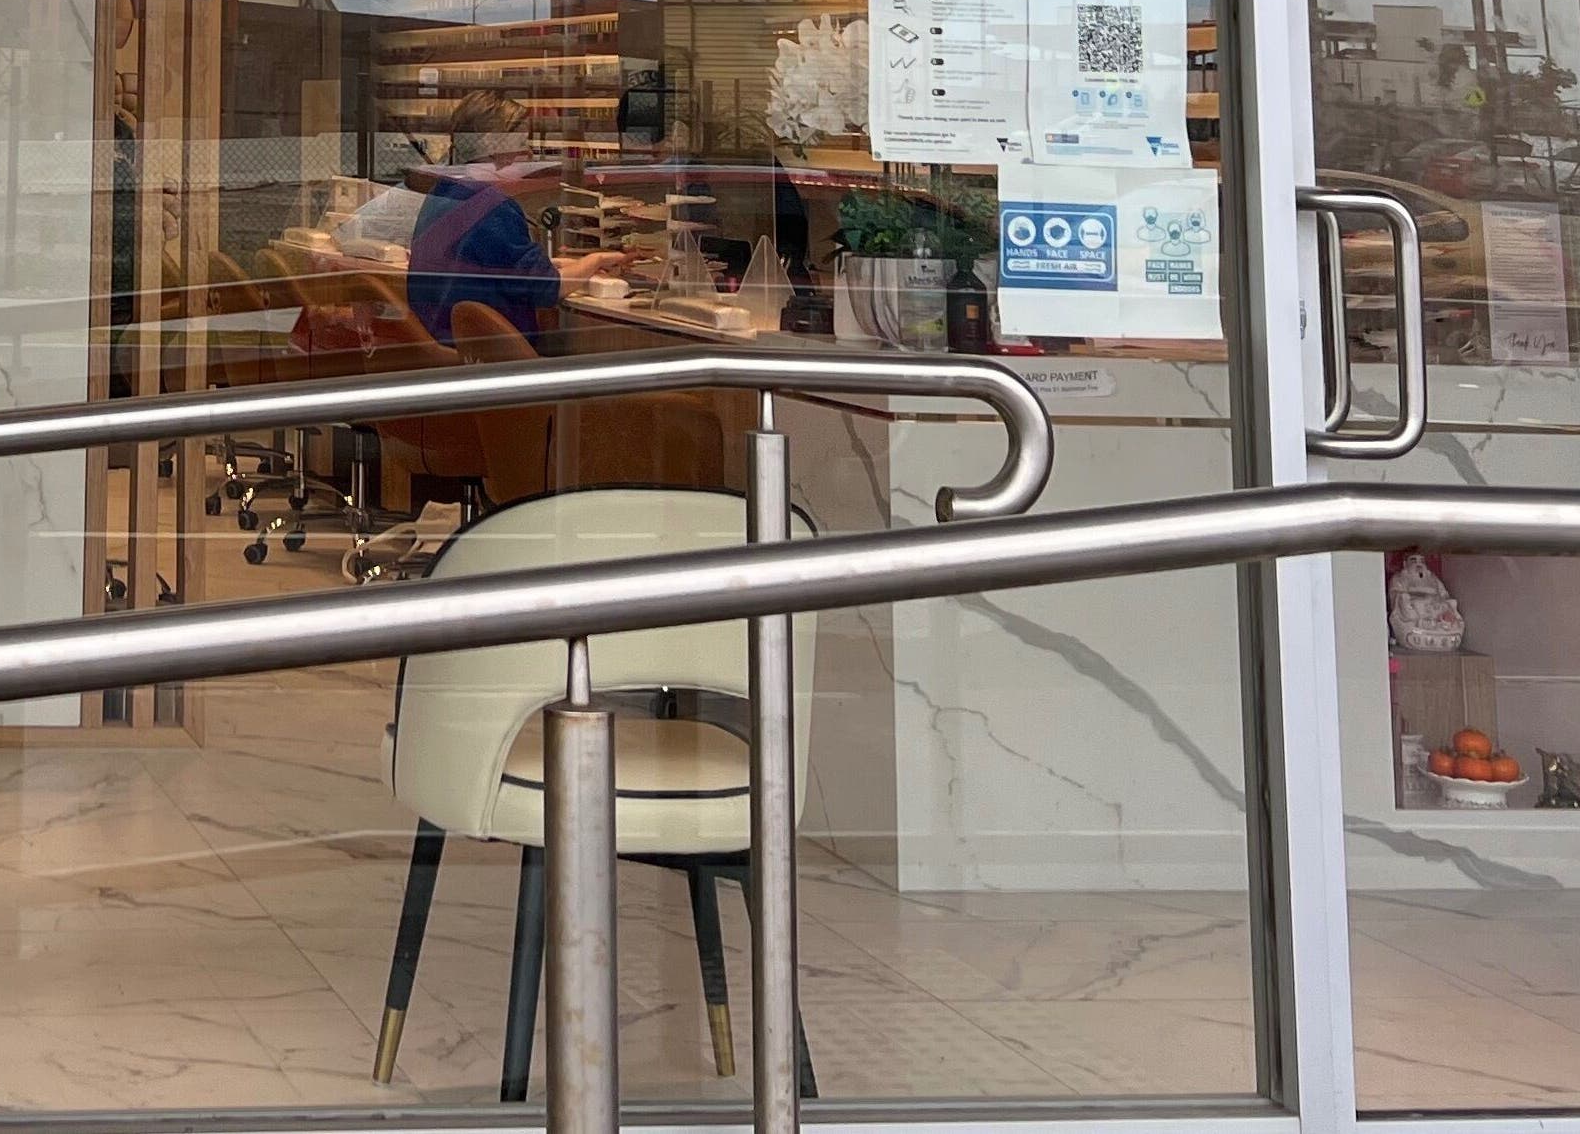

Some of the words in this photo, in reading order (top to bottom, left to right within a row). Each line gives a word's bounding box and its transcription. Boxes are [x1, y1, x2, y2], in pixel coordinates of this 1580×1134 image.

[1006, 248, 1038, 257] HANDS
[1046, 249, 1068, 258] FACE
[1080, 250, 1106, 259] SPACE
[1036, 262, 1062, 271] FRESH
[1050, 370, 1099, 382] PAYMENT
